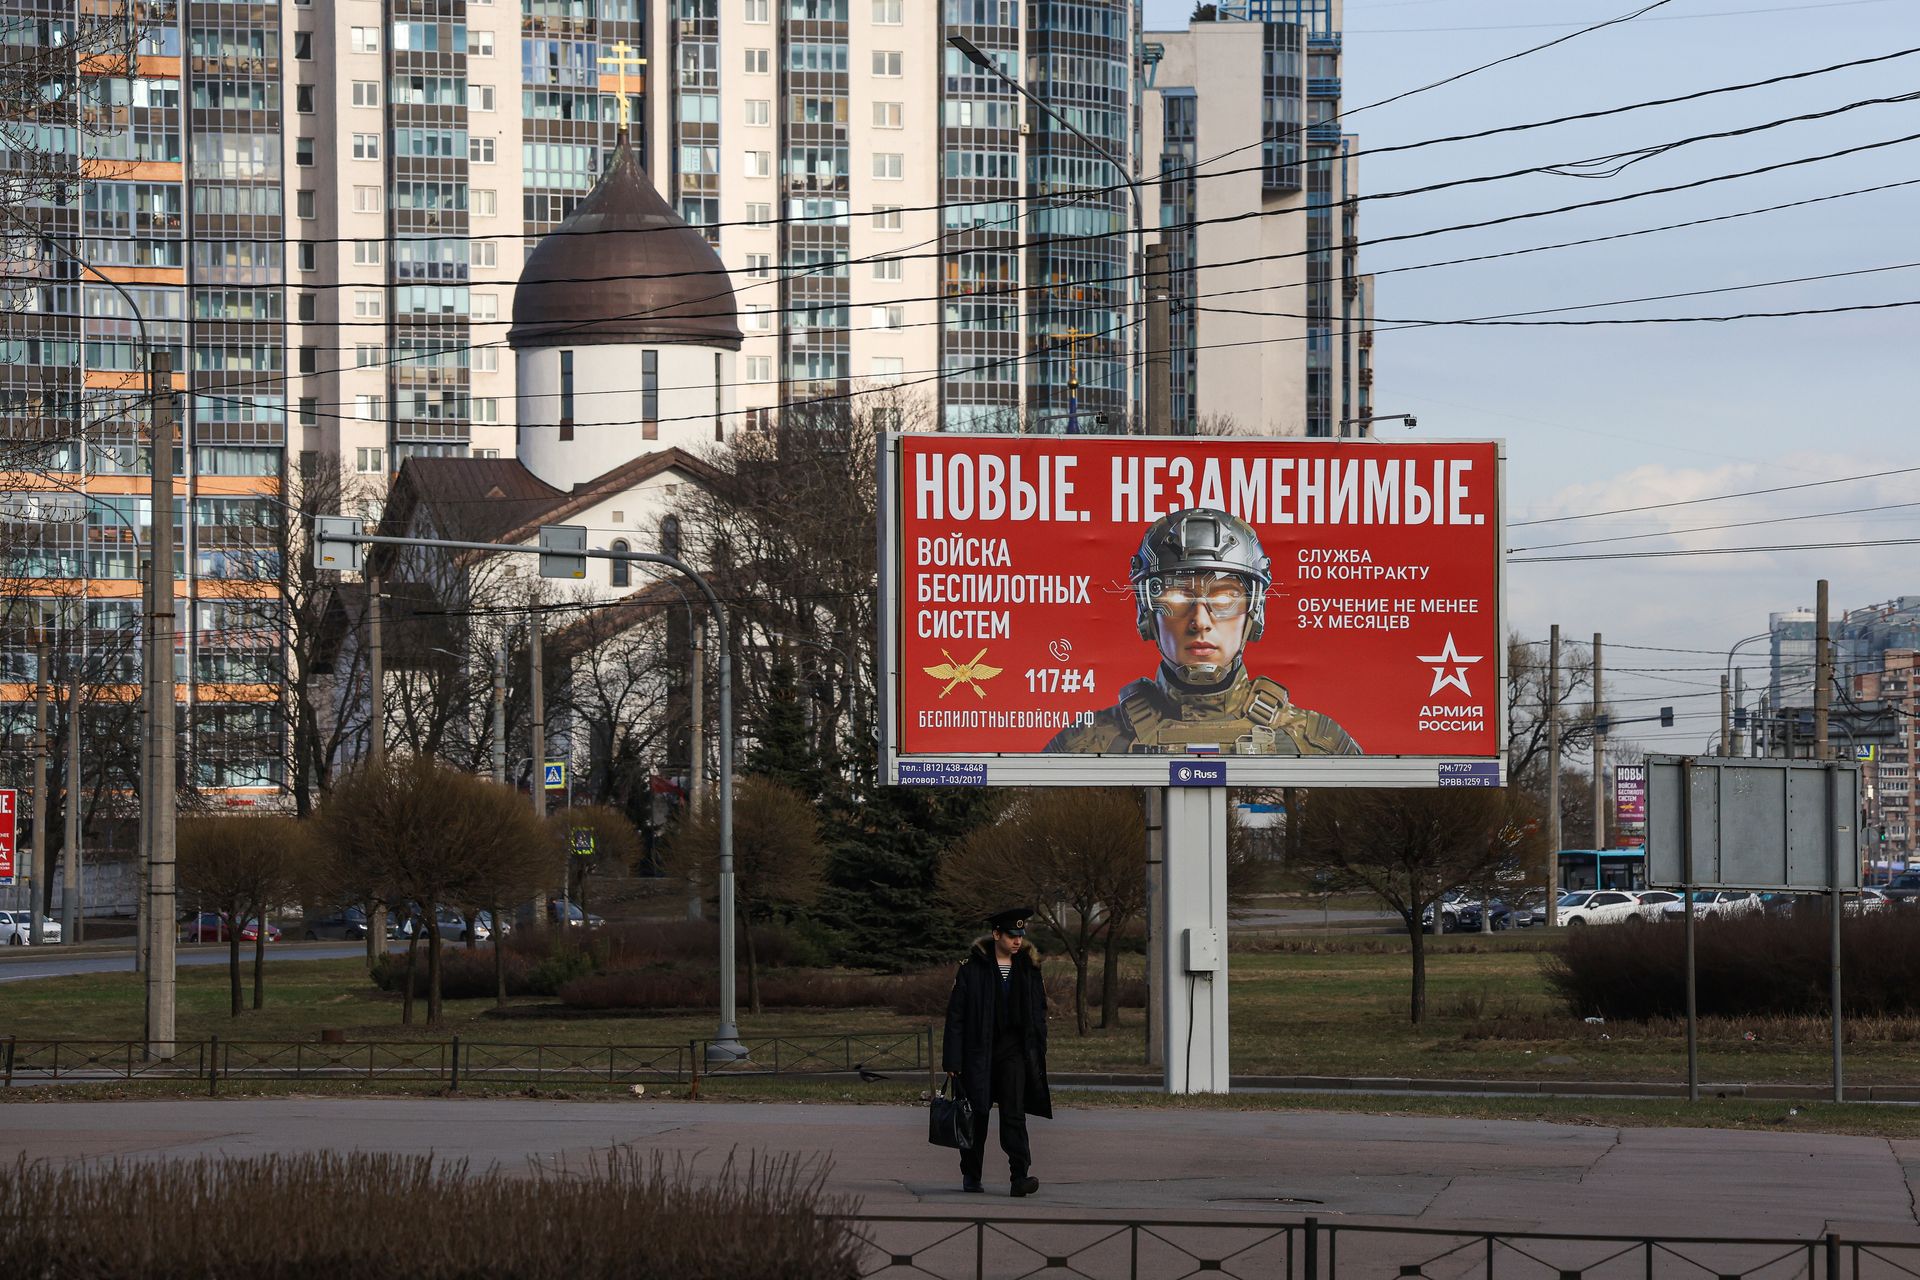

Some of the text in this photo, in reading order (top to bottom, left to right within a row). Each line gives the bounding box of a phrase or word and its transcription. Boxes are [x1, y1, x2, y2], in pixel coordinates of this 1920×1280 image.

[916, 453, 1485, 525] НОВЫЕ. НЕЗАМЕНИМЫЕ.
[918, 532, 1012, 567] ВОЙСКА
[1298, 549, 1373, 563] СЛУЖБА
[1298, 565, 1430, 580] ПО КОНТРАКТУ
[918, 573, 1091, 604] БЕСПИЛОТНЫХ
[1298, 598, 1479, 613] ОБУЧЕНИЕ НЕ МЕНЕЕ
[918, 609, 1010, 639] СИСТЕМ
[1297, 615, 1410, 631] 3-Х МЕСЯЦЕВ
[1025, 668, 1096, 693] 117#4
[919, 708, 1095, 728] БЕСПИЛОТНЫЕВОЙСКА.РФ
[1419, 705, 1484, 717] АРМИЯ
[1418, 720, 1484, 732] РОССИИ
[901, 764, 921, 772] тел.:
[945, 763, 984, 772] 438-4848
[1193, 769, 1218, 779] Russ
[901, 775, 982, 786] договор: Т-03/2017
[1440, 778, 1480, 786] SPBB:1259
